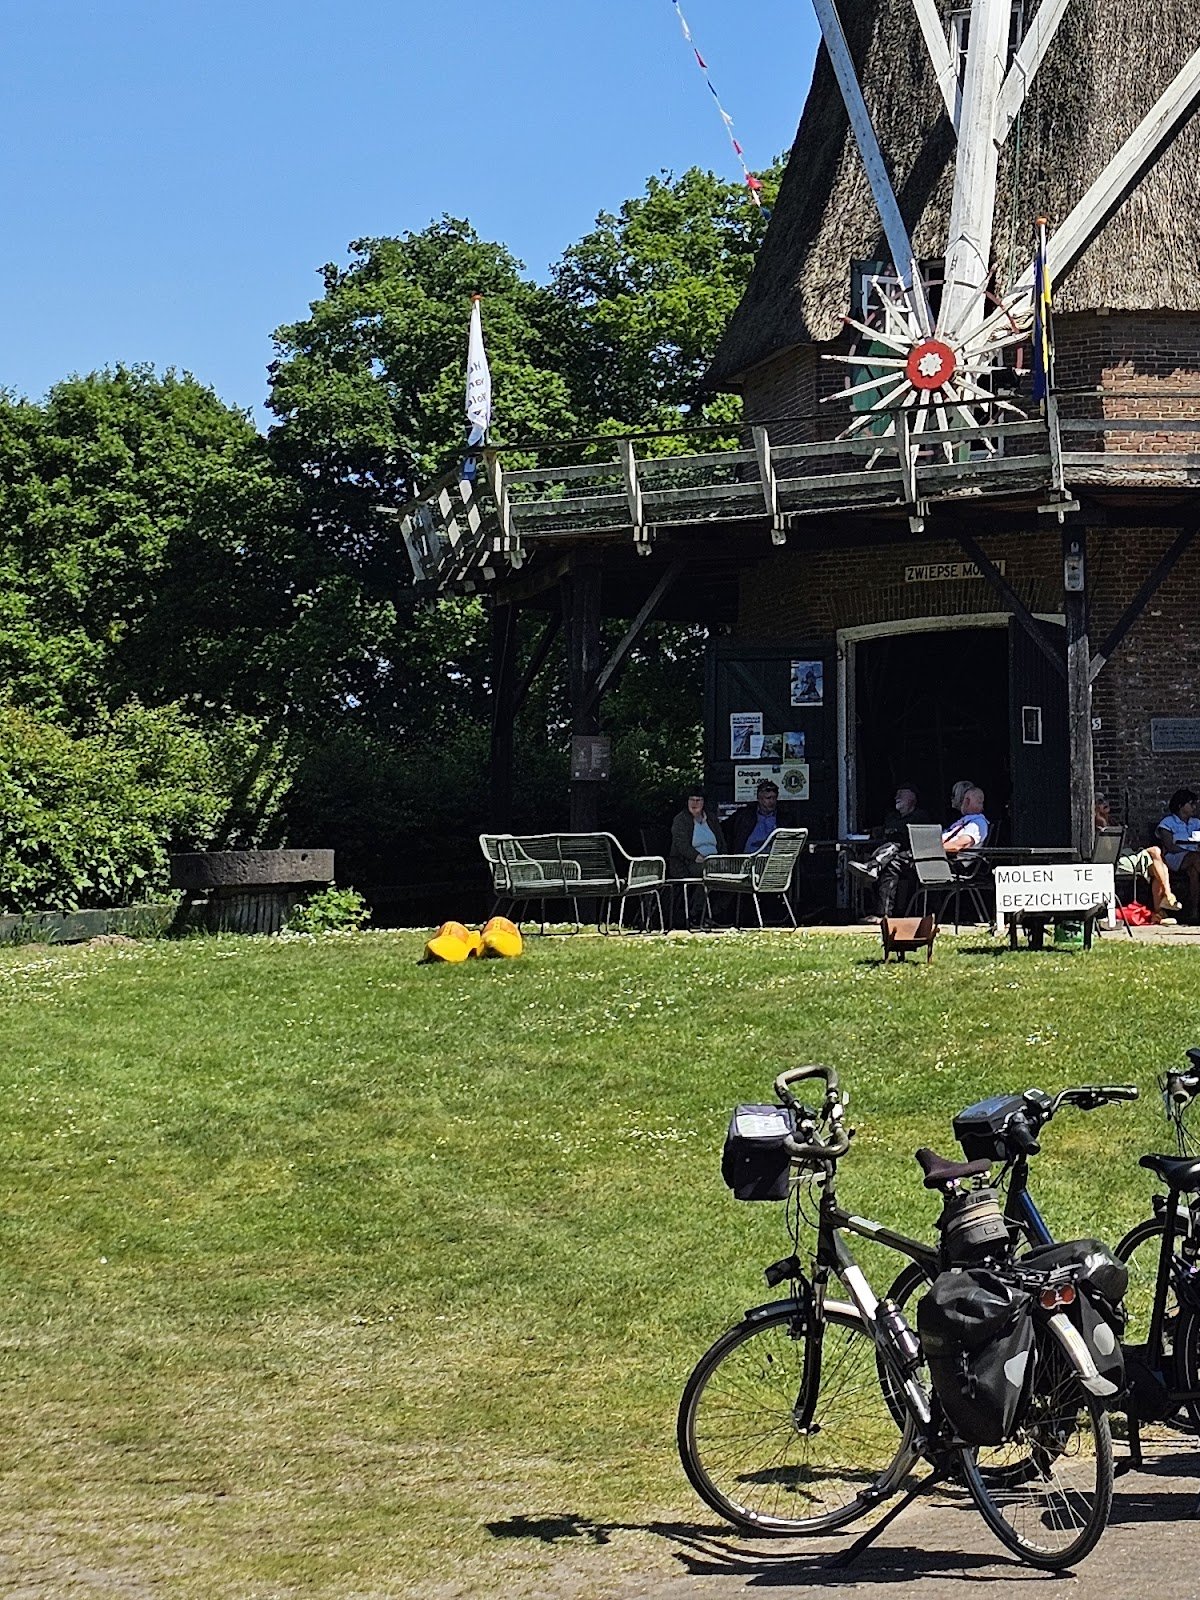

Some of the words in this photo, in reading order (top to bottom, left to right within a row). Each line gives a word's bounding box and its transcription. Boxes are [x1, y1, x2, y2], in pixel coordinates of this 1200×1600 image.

[907, 564, 959, 581] ZWIEPSE
[998, 870, 1053, 884] MOLEN
[1073, 869, 1093, 881] TE
[1003, 892, 1112, 907] BEZICHTIGEN
